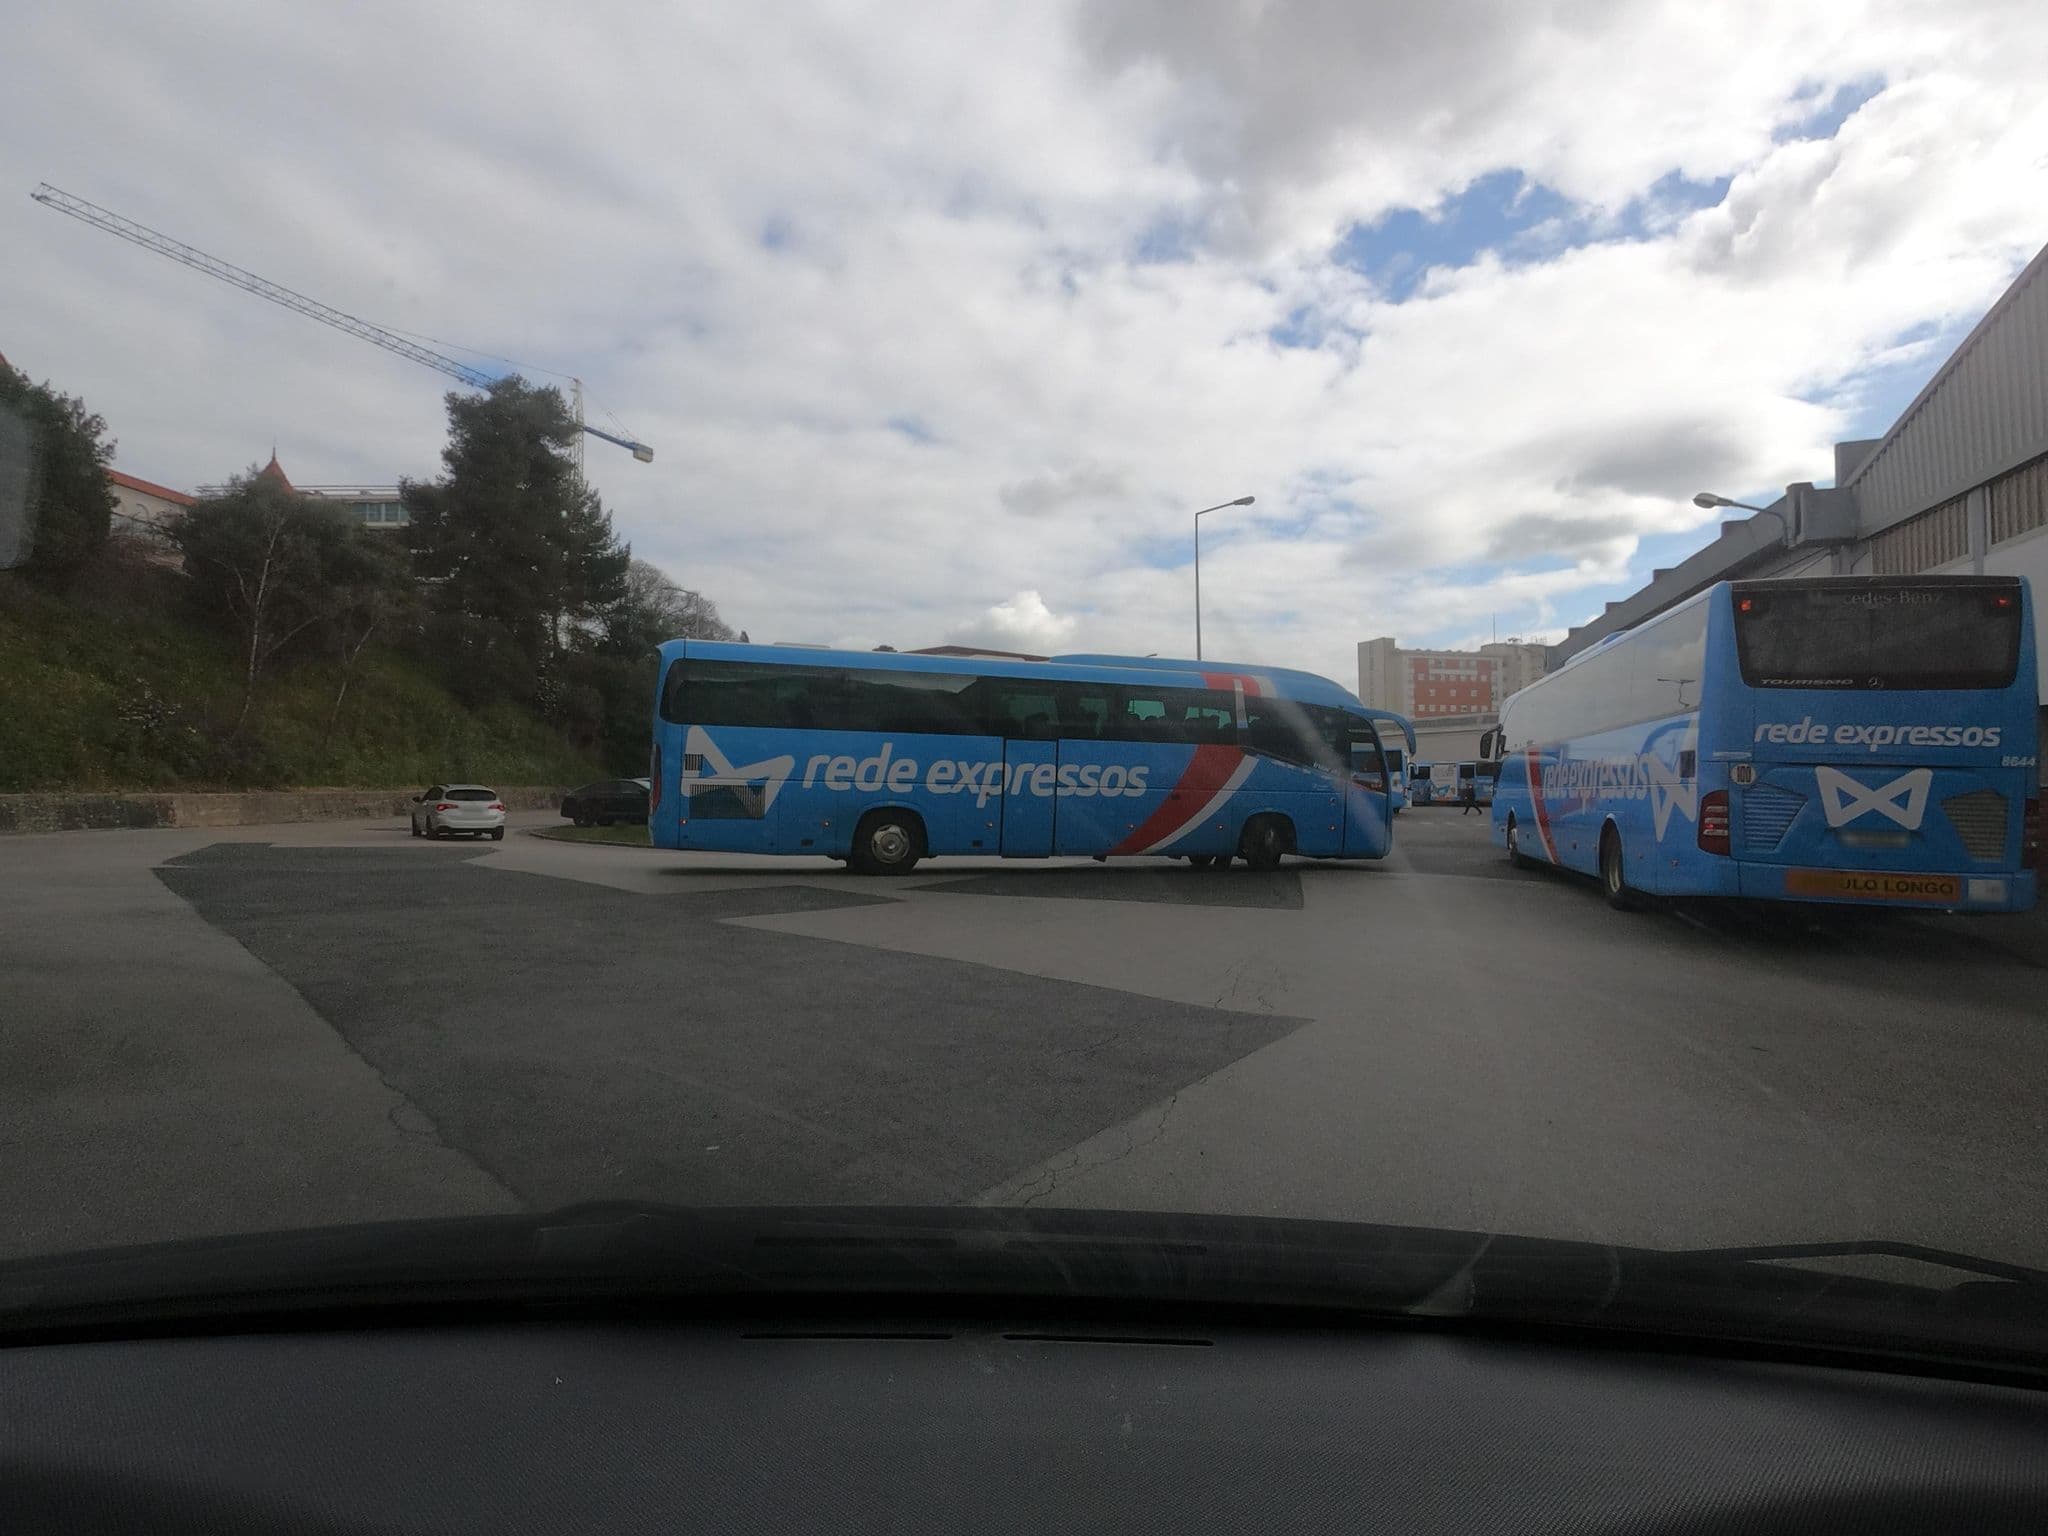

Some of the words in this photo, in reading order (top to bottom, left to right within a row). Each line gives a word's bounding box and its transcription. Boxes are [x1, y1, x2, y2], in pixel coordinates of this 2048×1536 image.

[1754, 716, 1828, 745] rede
[1834, 723, 2002, 752] expressos
[802, 742, 919, 793] rede
[926, 758, 1150, 808] expressos
[1542, 747, 1568, 800] rede
[1884, 877, 1954, 895] LONGO
